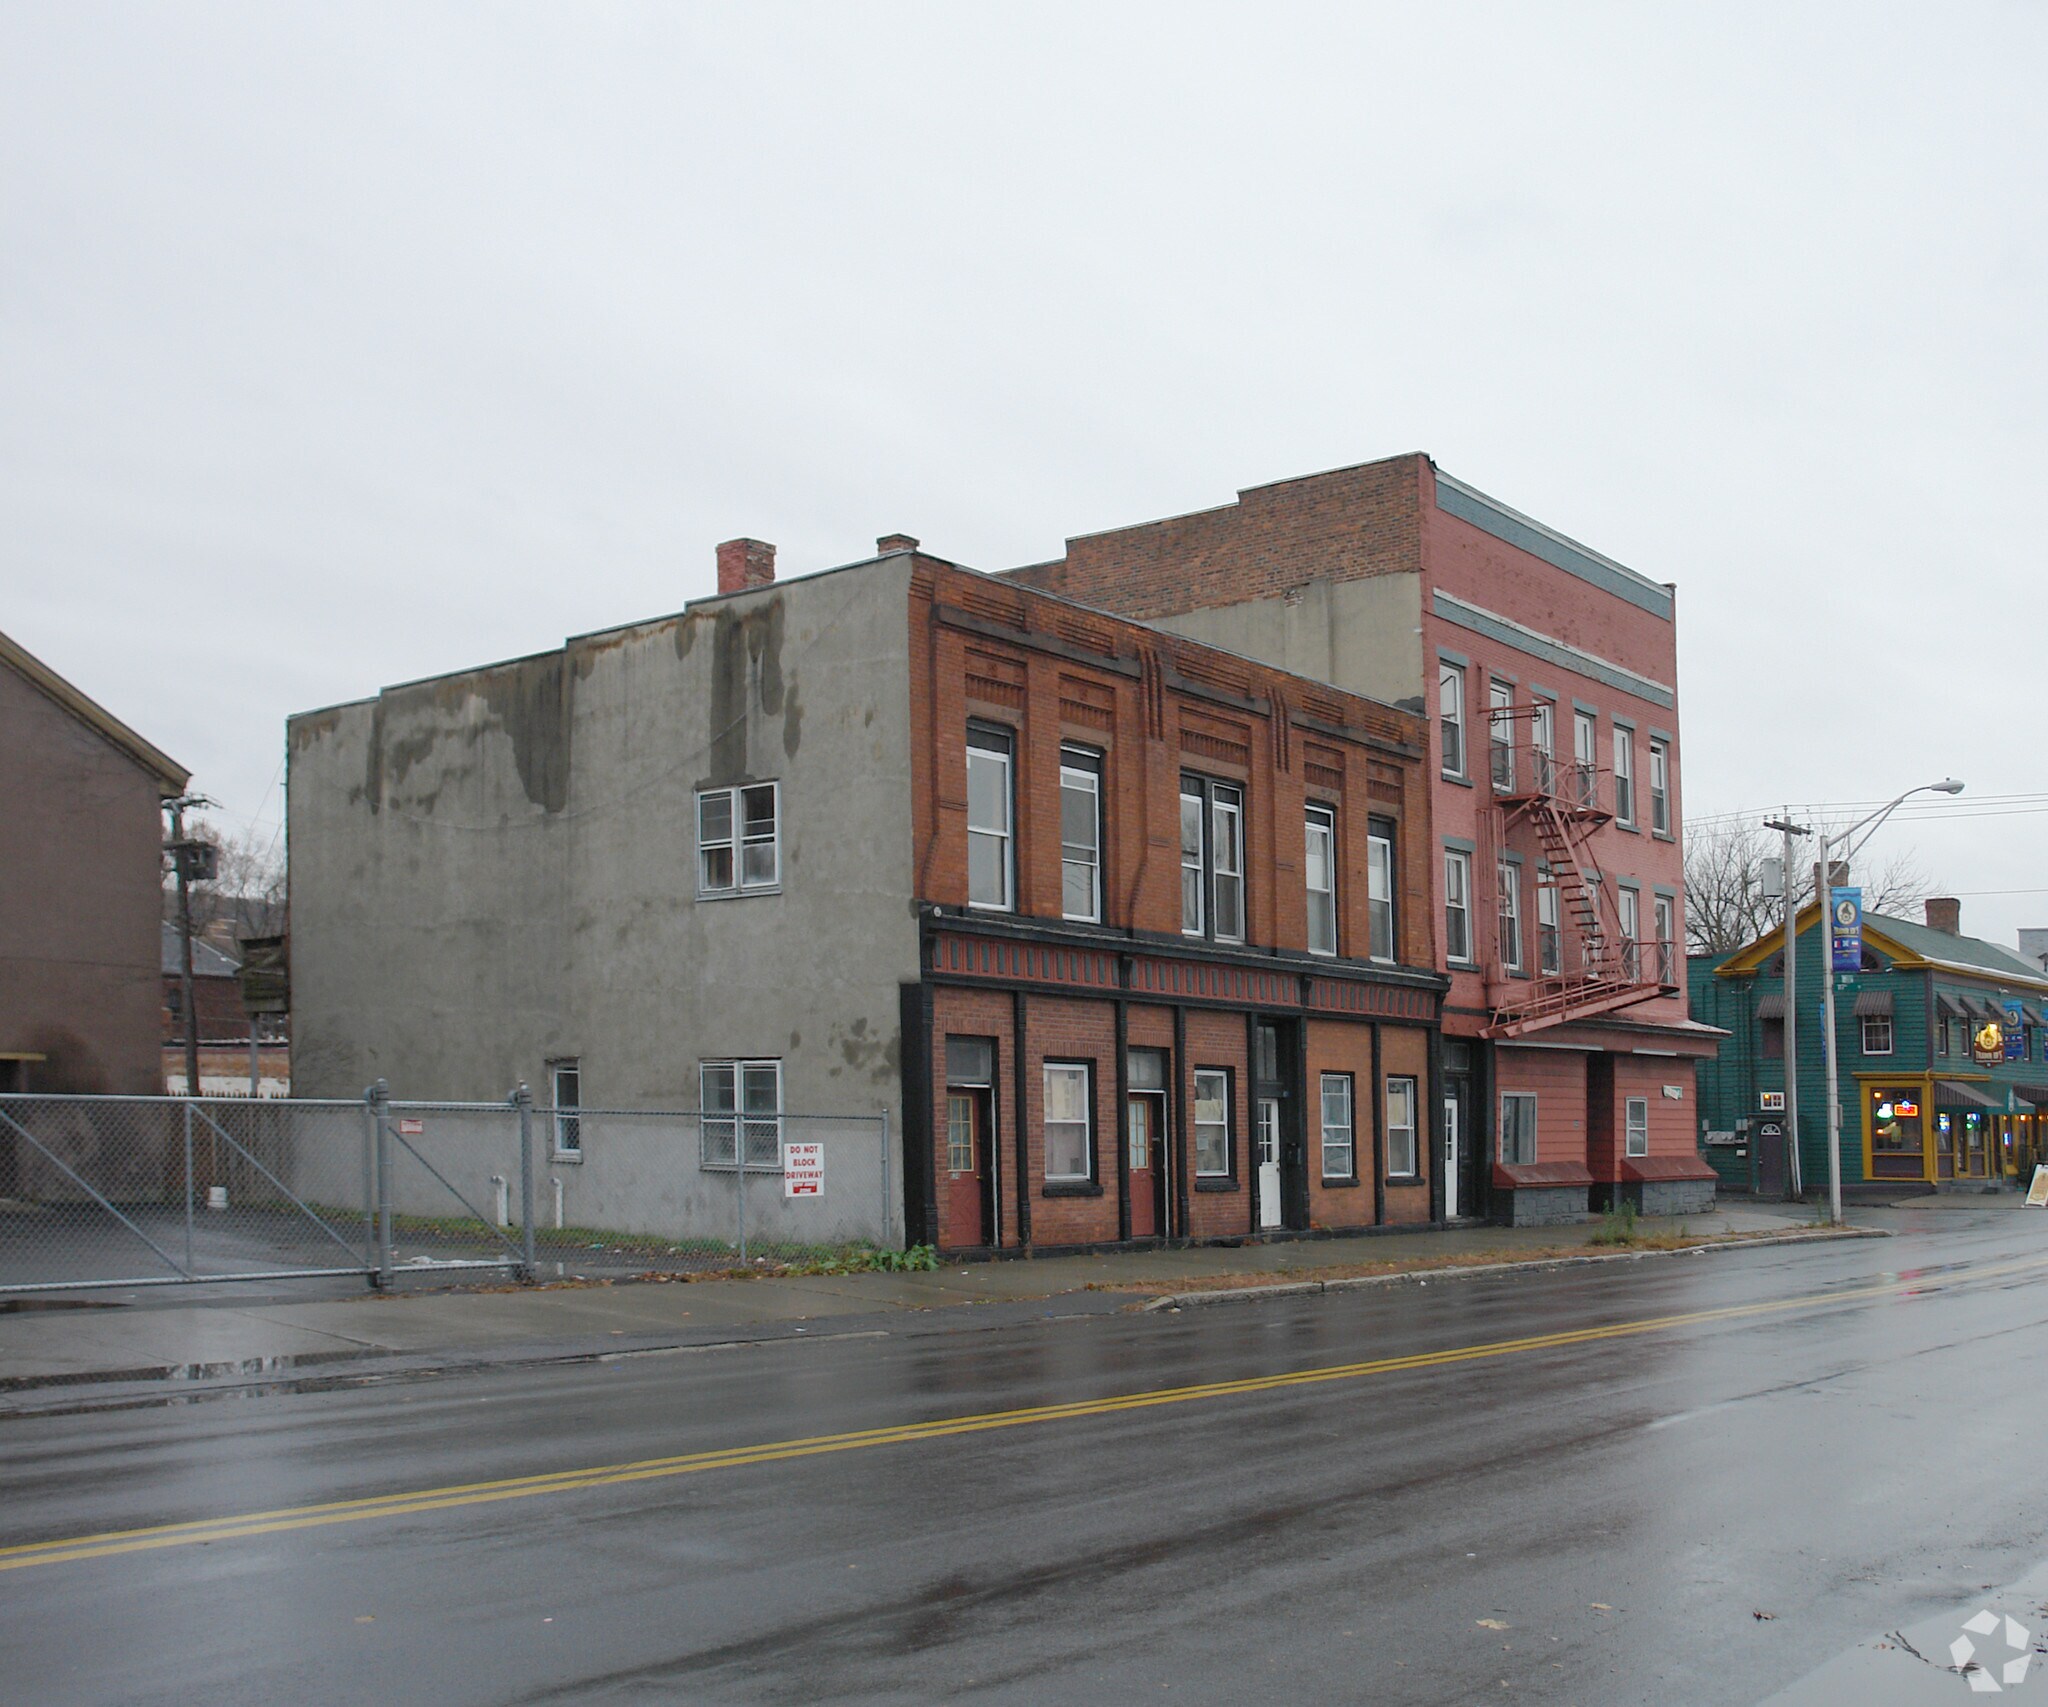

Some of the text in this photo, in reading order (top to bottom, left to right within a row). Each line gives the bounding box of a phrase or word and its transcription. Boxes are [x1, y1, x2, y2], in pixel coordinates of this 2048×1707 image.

[790, 1145, 818, 1154] DO NOT
[793, 1158, 816, 1167] BLOCK
[785, 1171, 823, 1179] DRIVEWAY
